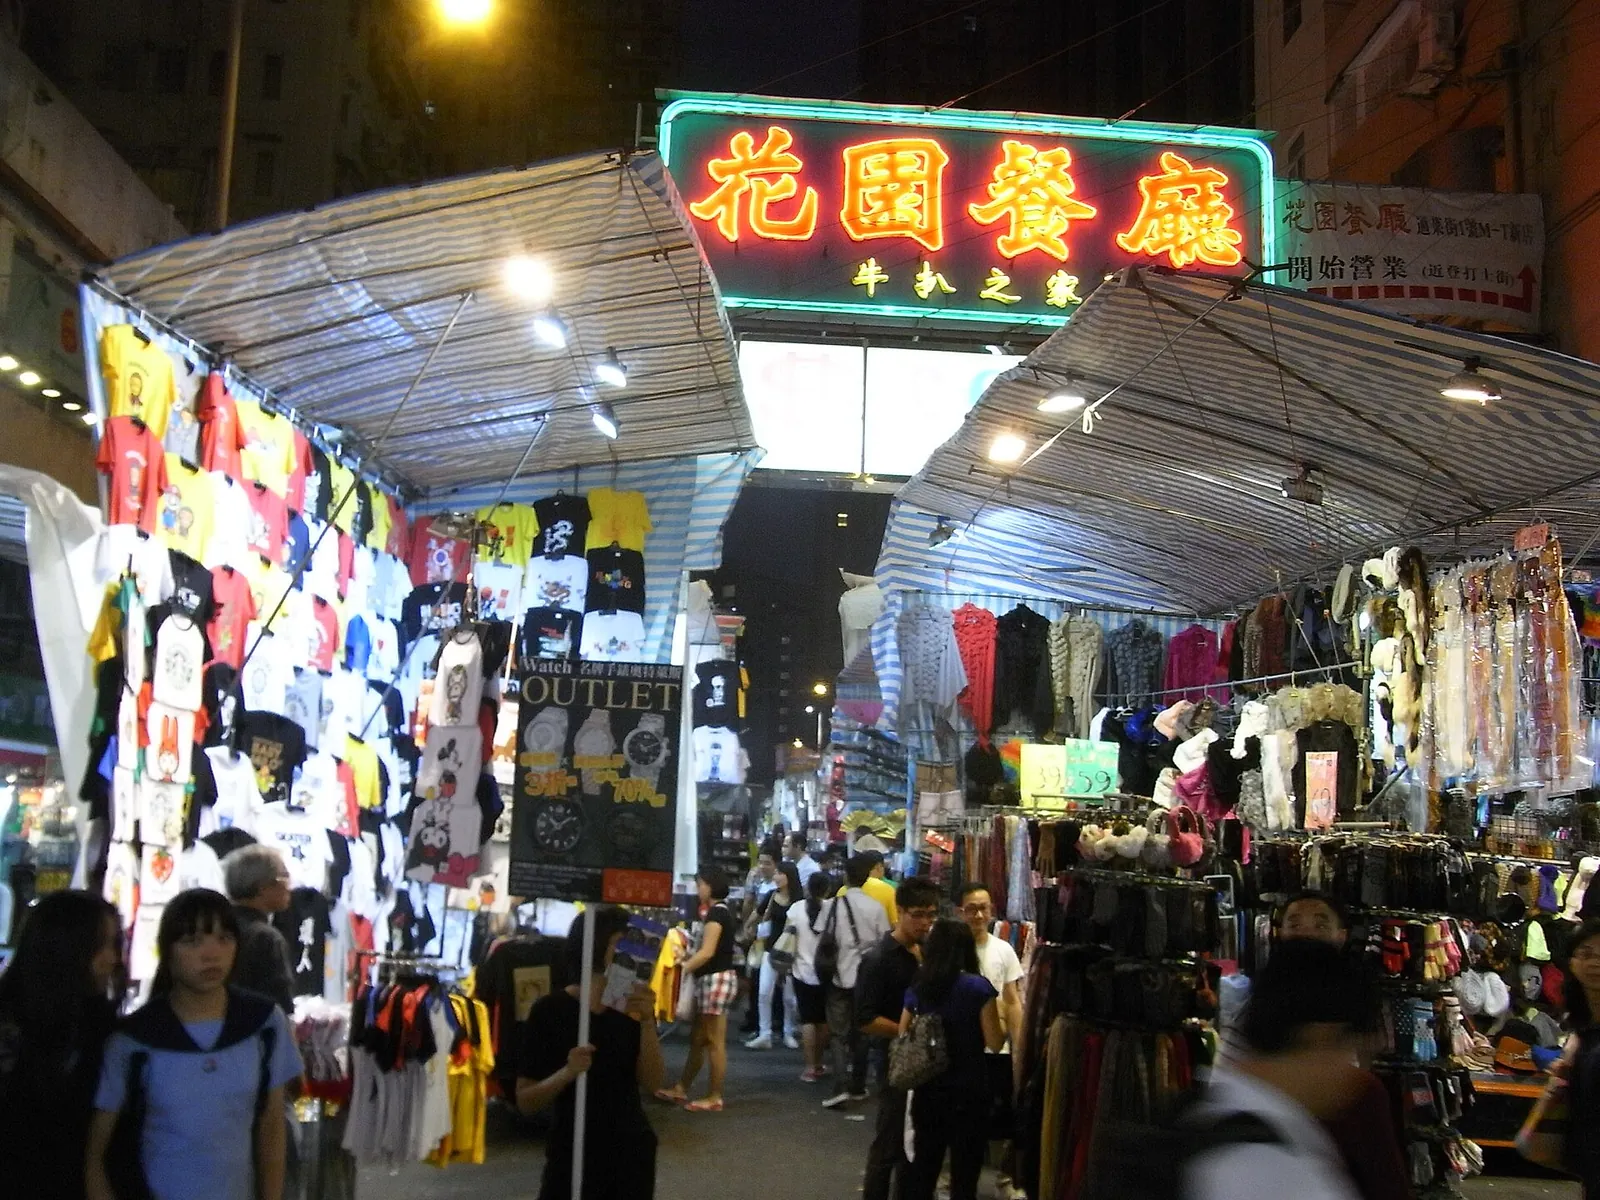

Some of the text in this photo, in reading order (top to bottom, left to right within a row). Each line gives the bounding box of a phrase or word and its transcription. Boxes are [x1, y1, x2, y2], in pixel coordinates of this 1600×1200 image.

[690, 126, 1243, 269] 花園餐廳
[852, 257, 1083, 309] 牛扒之家
[1287, 254, 1408, 283] 開始營業
[520, 657, 572, 675] Watch
[522, 675, 680, 711] OUTLET
[1078, 770, 1112, 793] 59
